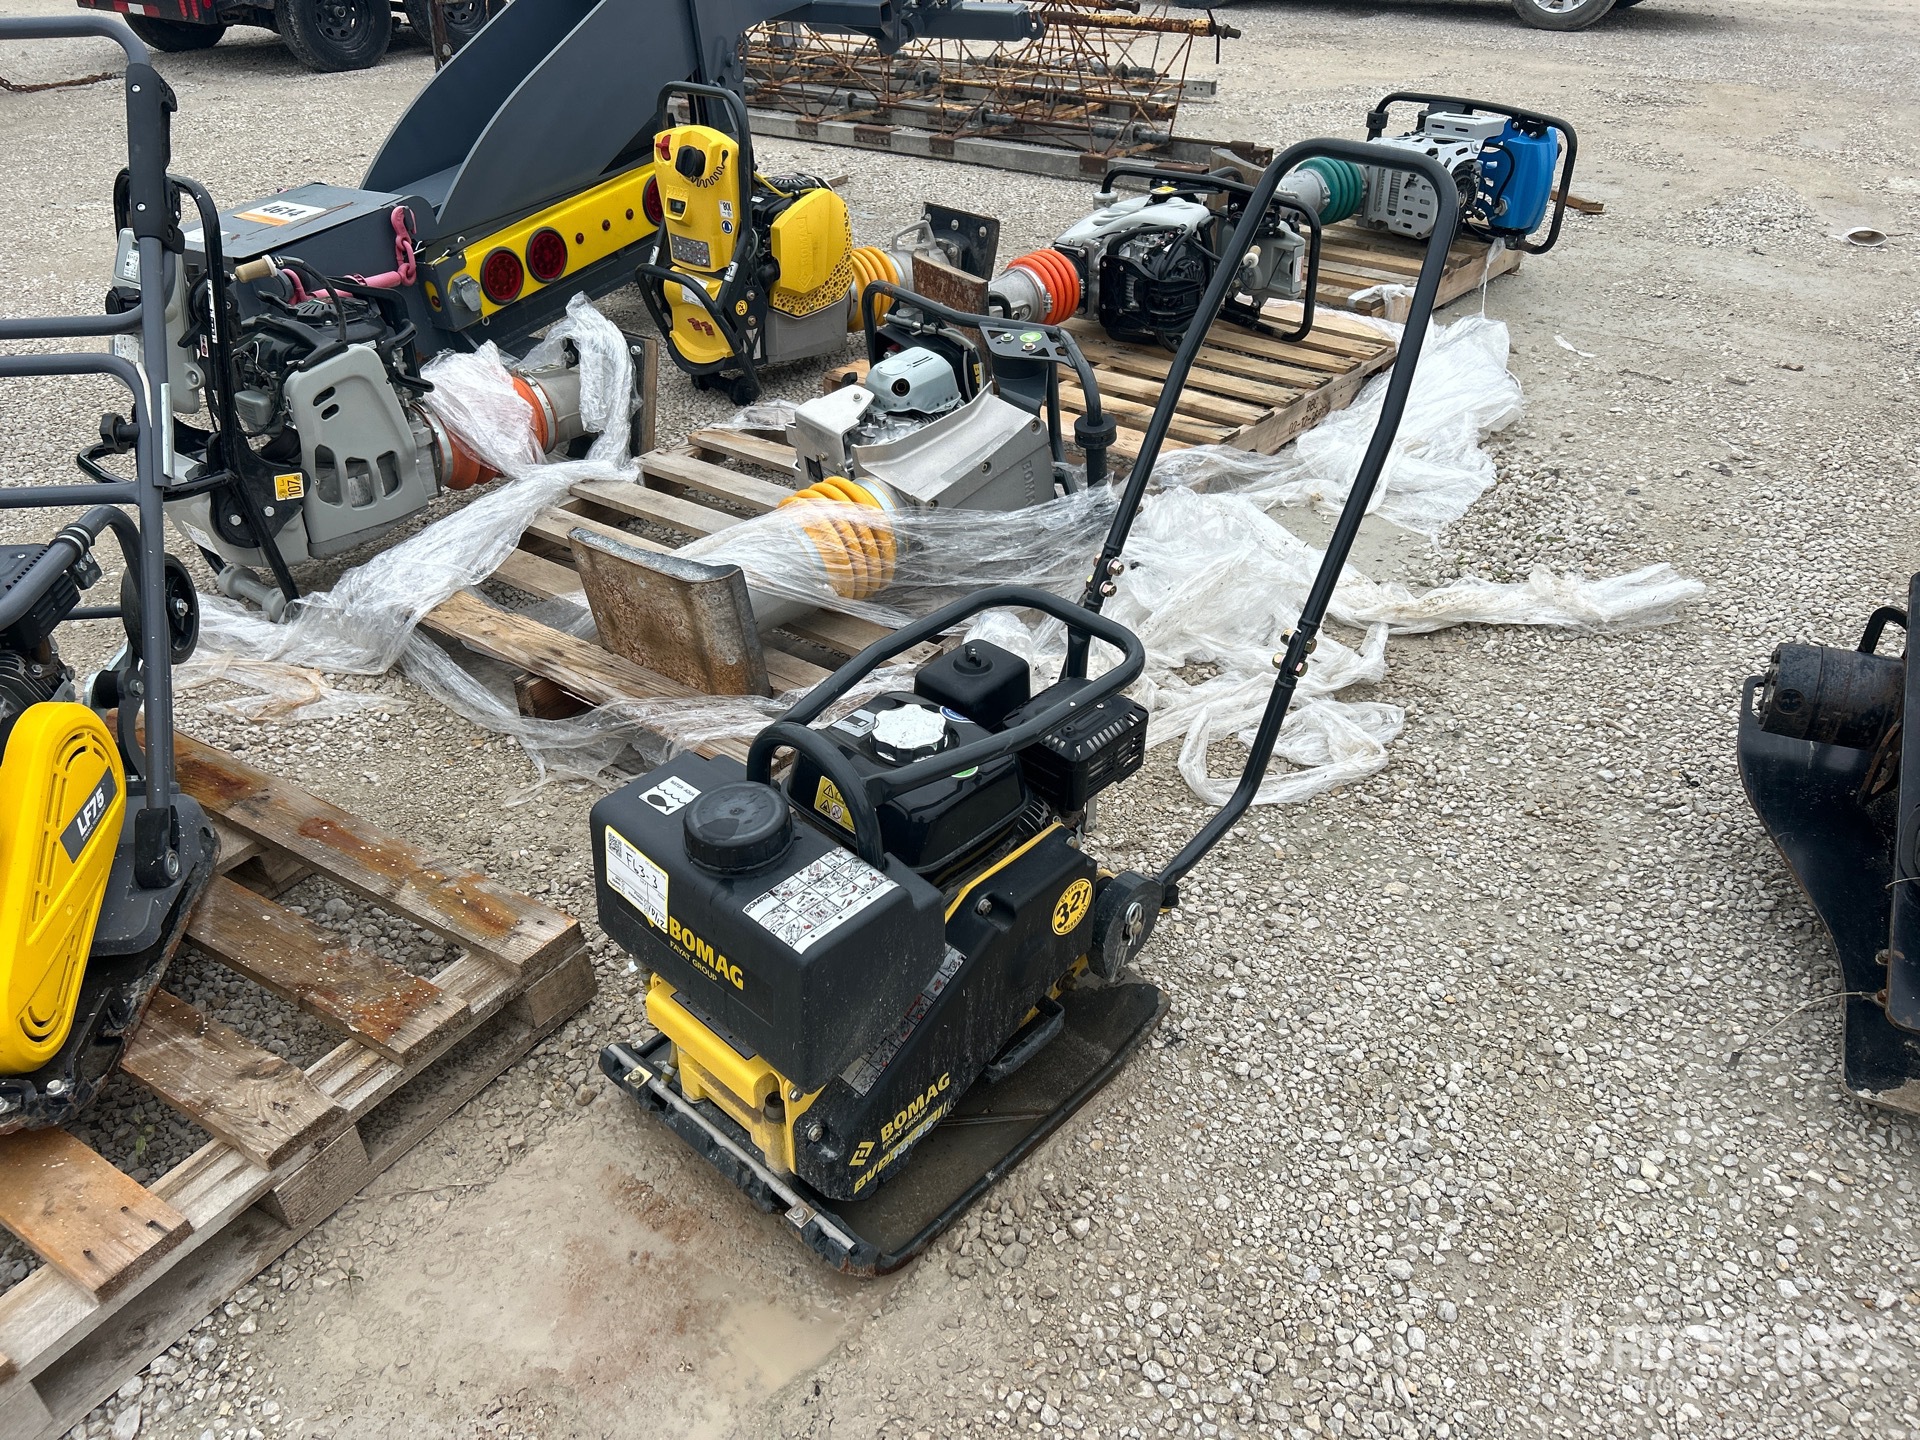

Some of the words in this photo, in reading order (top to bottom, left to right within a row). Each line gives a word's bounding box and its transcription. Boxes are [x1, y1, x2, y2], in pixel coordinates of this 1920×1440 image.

[261, 205, 306, 217] 4614
[287, 480, 302, 497] 107
[1022, 459, 1036, 507] BOMA
[76, 787, 105, 837] LF75
[669, 915, 744, 991] BOMAG
[669, 940, 691, 961] FAYAT
[692, 958, 718, 981] GROUP
[880, 1071, 951, 1143] BOMAG
[882, 1128, 904, 1150] FAYAT
[904, 1107, 928, 1131] GROUP
